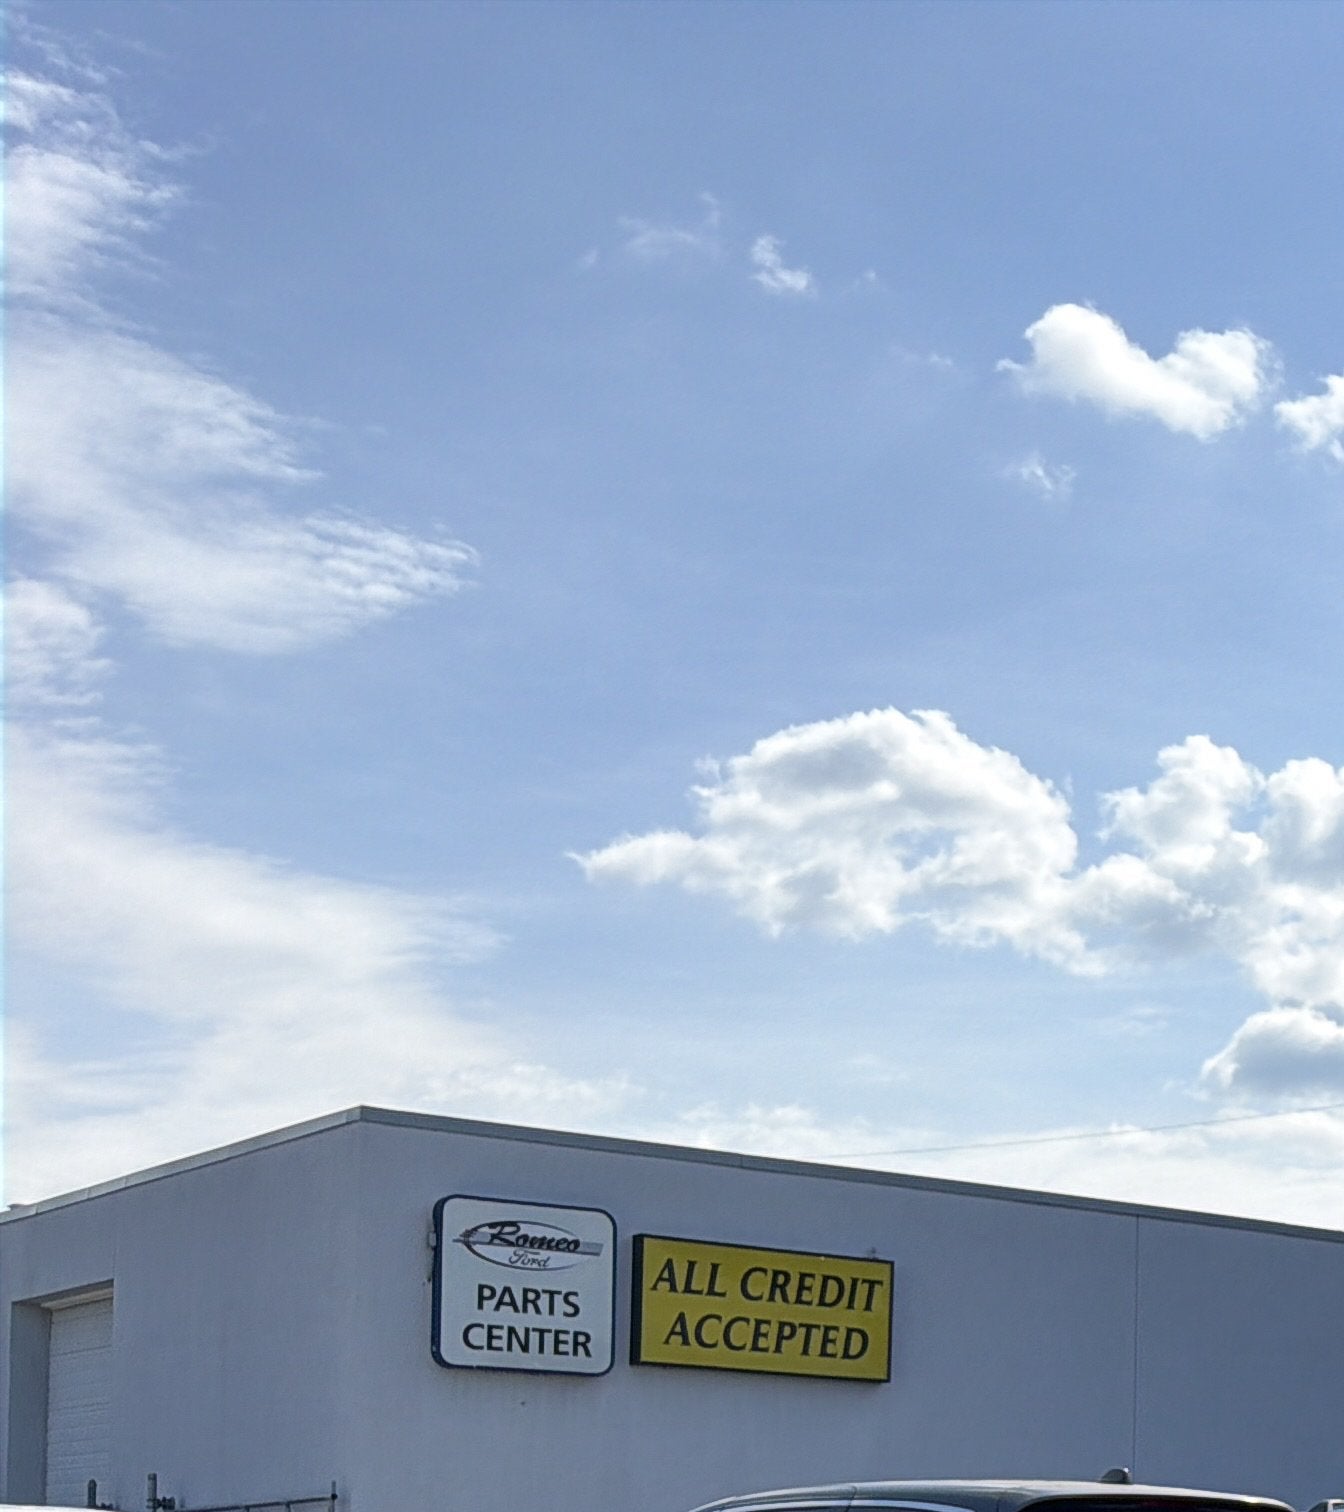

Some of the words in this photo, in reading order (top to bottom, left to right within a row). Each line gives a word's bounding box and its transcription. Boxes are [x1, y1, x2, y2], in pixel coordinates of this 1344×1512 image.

[487, 1220, 581, 1253] Romeo
[508, 1250, 552, 1269] Ford
[477, 1283, 581, 1319] PARTS
[650, 1257, 727, 1299] ALL
[739, 1267, 883, 1313] CREDIT
[462, 1322, 593, 1359] CENTER
[663, 1311, 871, 1362] ACCEPTED
